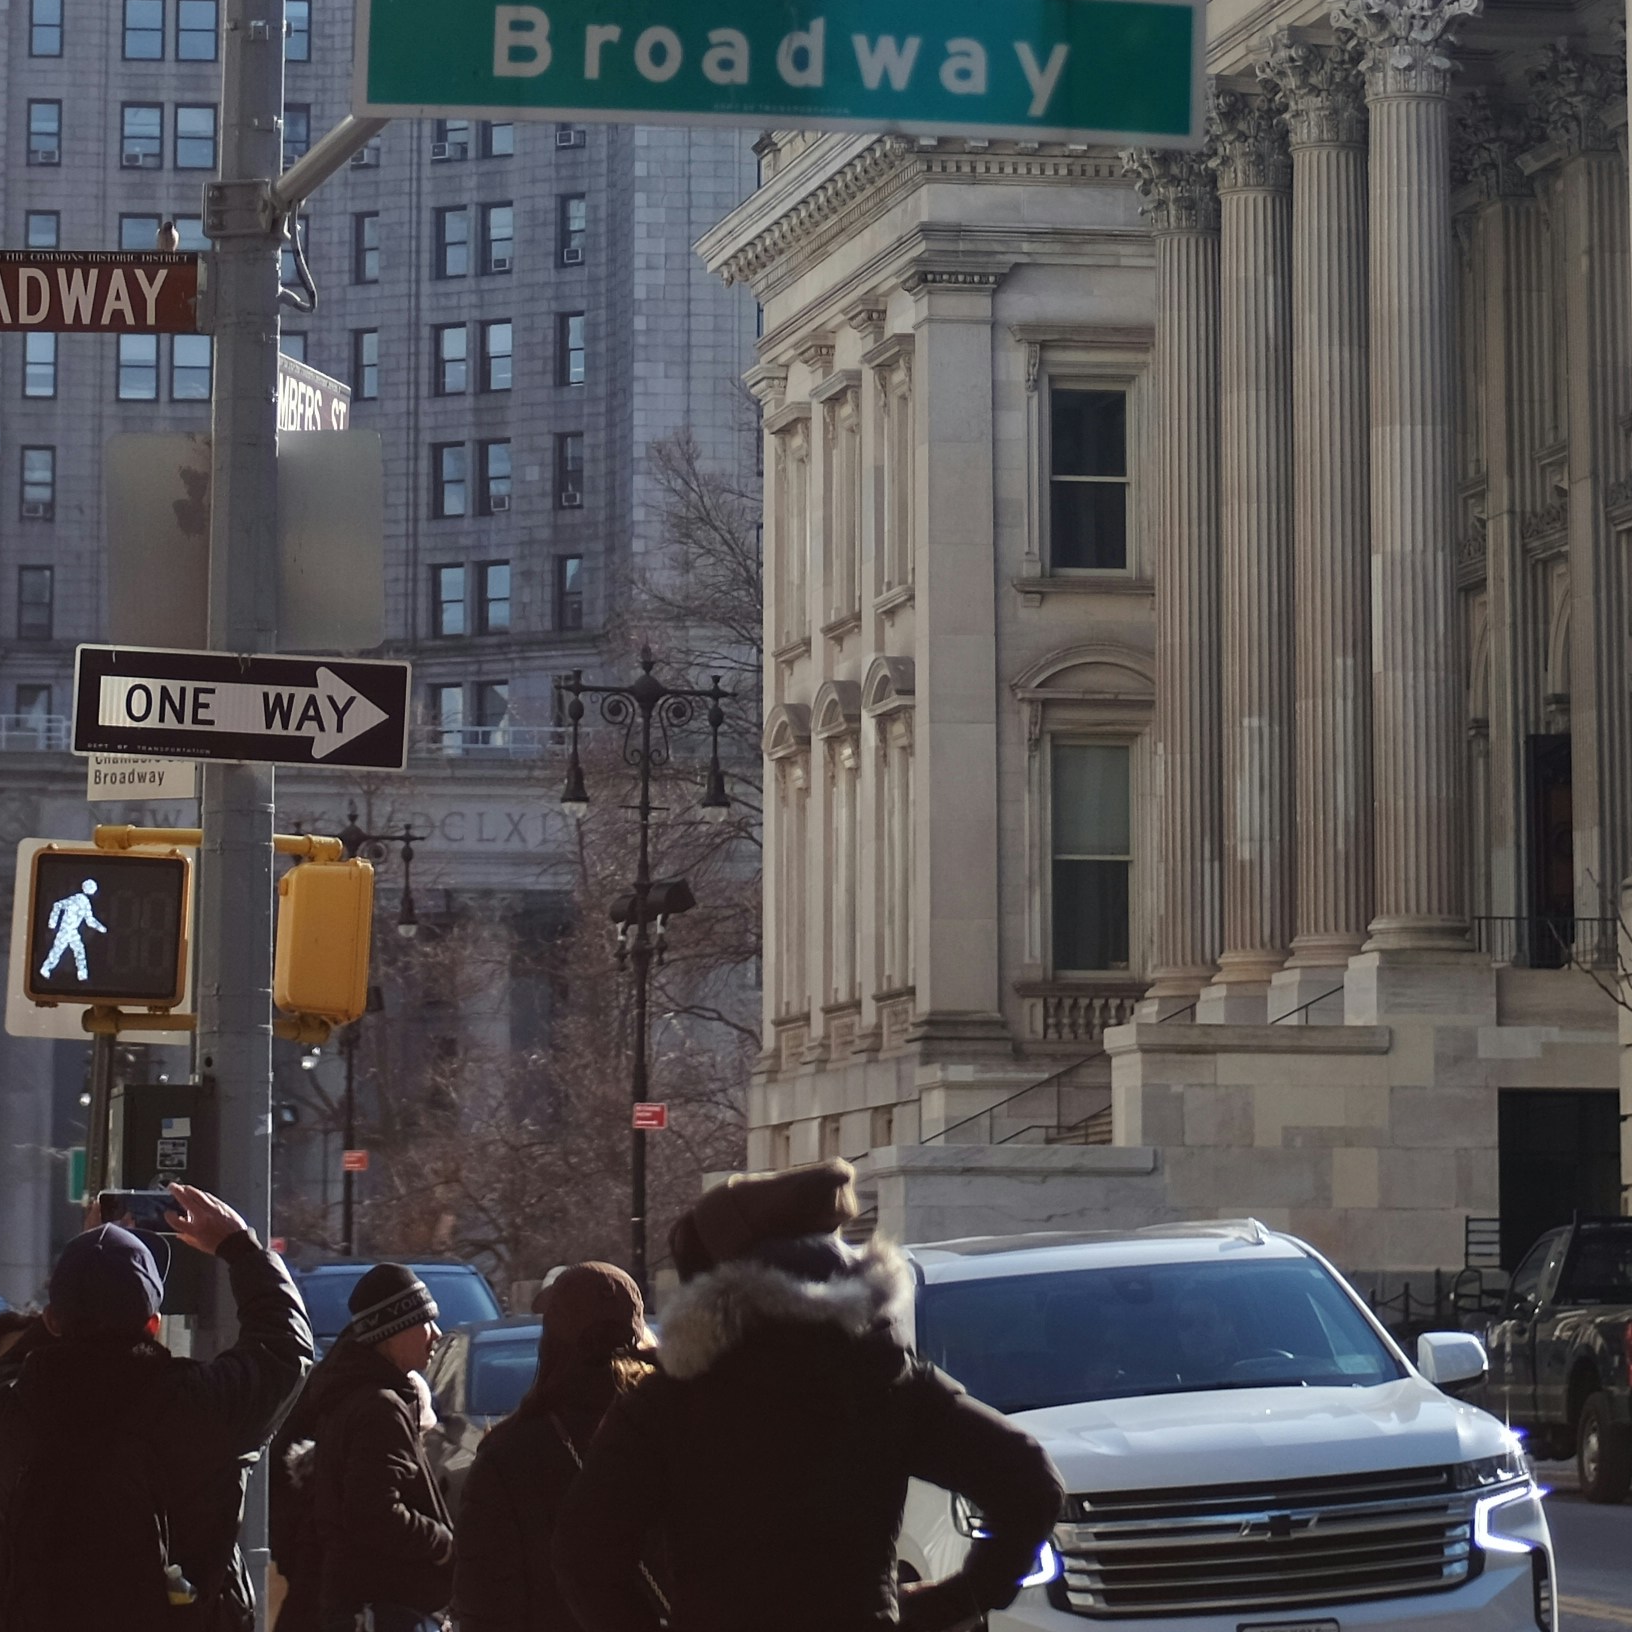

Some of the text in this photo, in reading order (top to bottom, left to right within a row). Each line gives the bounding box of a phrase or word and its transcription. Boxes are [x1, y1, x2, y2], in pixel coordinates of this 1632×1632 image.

[492, 4, 1070, 117] Broadway
[6, 252, 24, 261] THE
[31, 252, 84, 262] COMMONS
[88, 253, 138, 262] HISTORIC
[142, 254, 188, 263] DISTRICT
[278, 372, 323, 431] MBERS
[331, 398, 346, 430] ST
[125, 683, 357, 733] ONE WAY
[94, 769, 165, 786] Broadway
